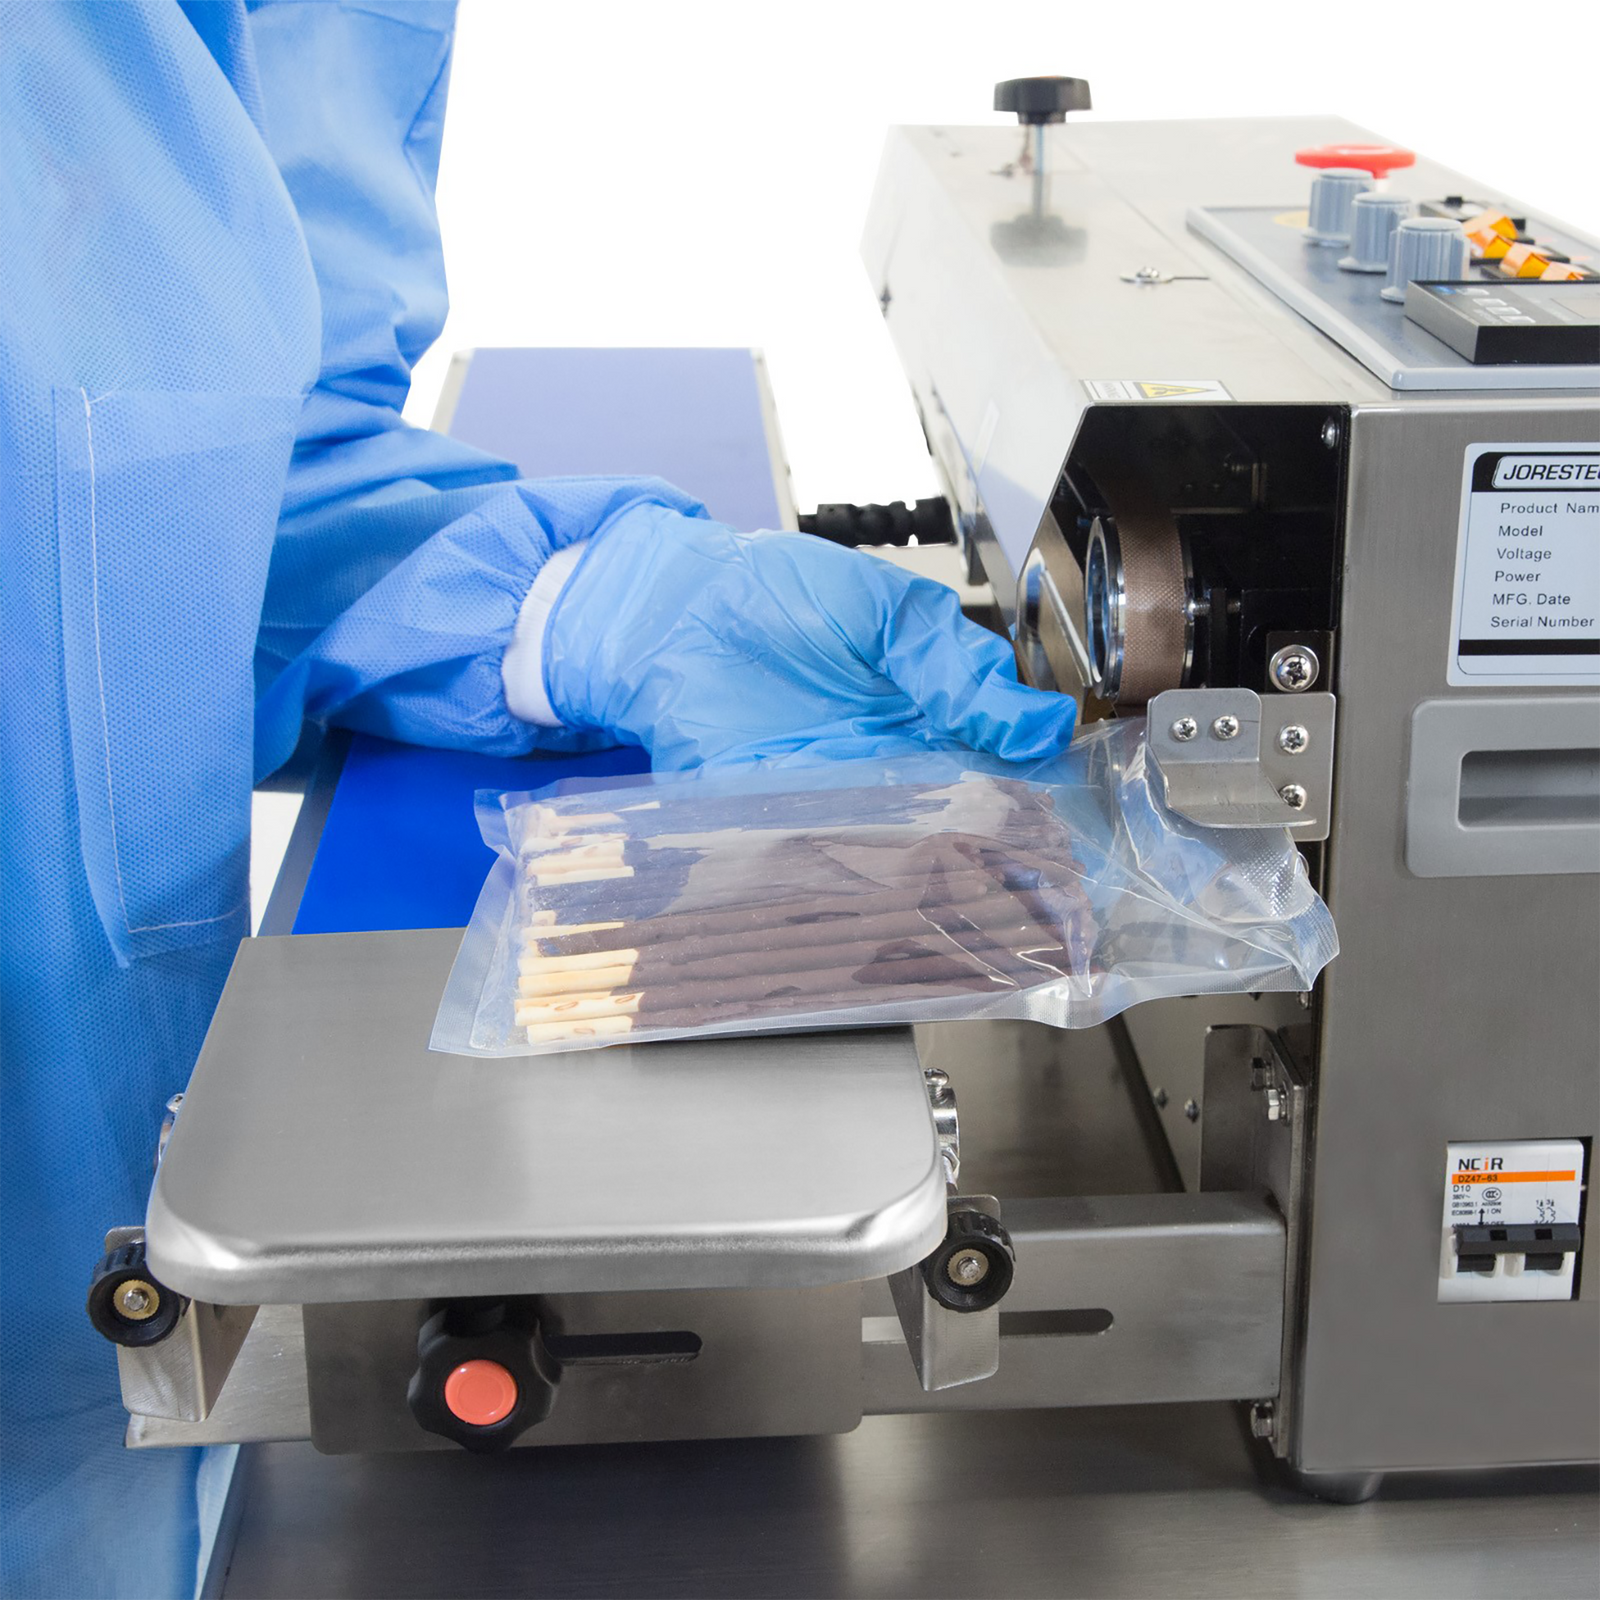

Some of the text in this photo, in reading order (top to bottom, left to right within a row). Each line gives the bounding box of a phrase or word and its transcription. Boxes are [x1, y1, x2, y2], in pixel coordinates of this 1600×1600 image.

[1503, 464, 1600, 480] JORESTE
[1500, 502, 1558, 514] Product
[1498, 525, 1543, 537] Model
[1496, 547, 1552, 562] Voltage
[1494, 570, 1541, 582] Power
[1492, 593, 1571, 605] MFG. Date
[1490, 616, 1595, 628] Serial Number
[1458, 1174, 1498, 1183] DZ47-63
[1453, 1184, 1471, 1193] D10
